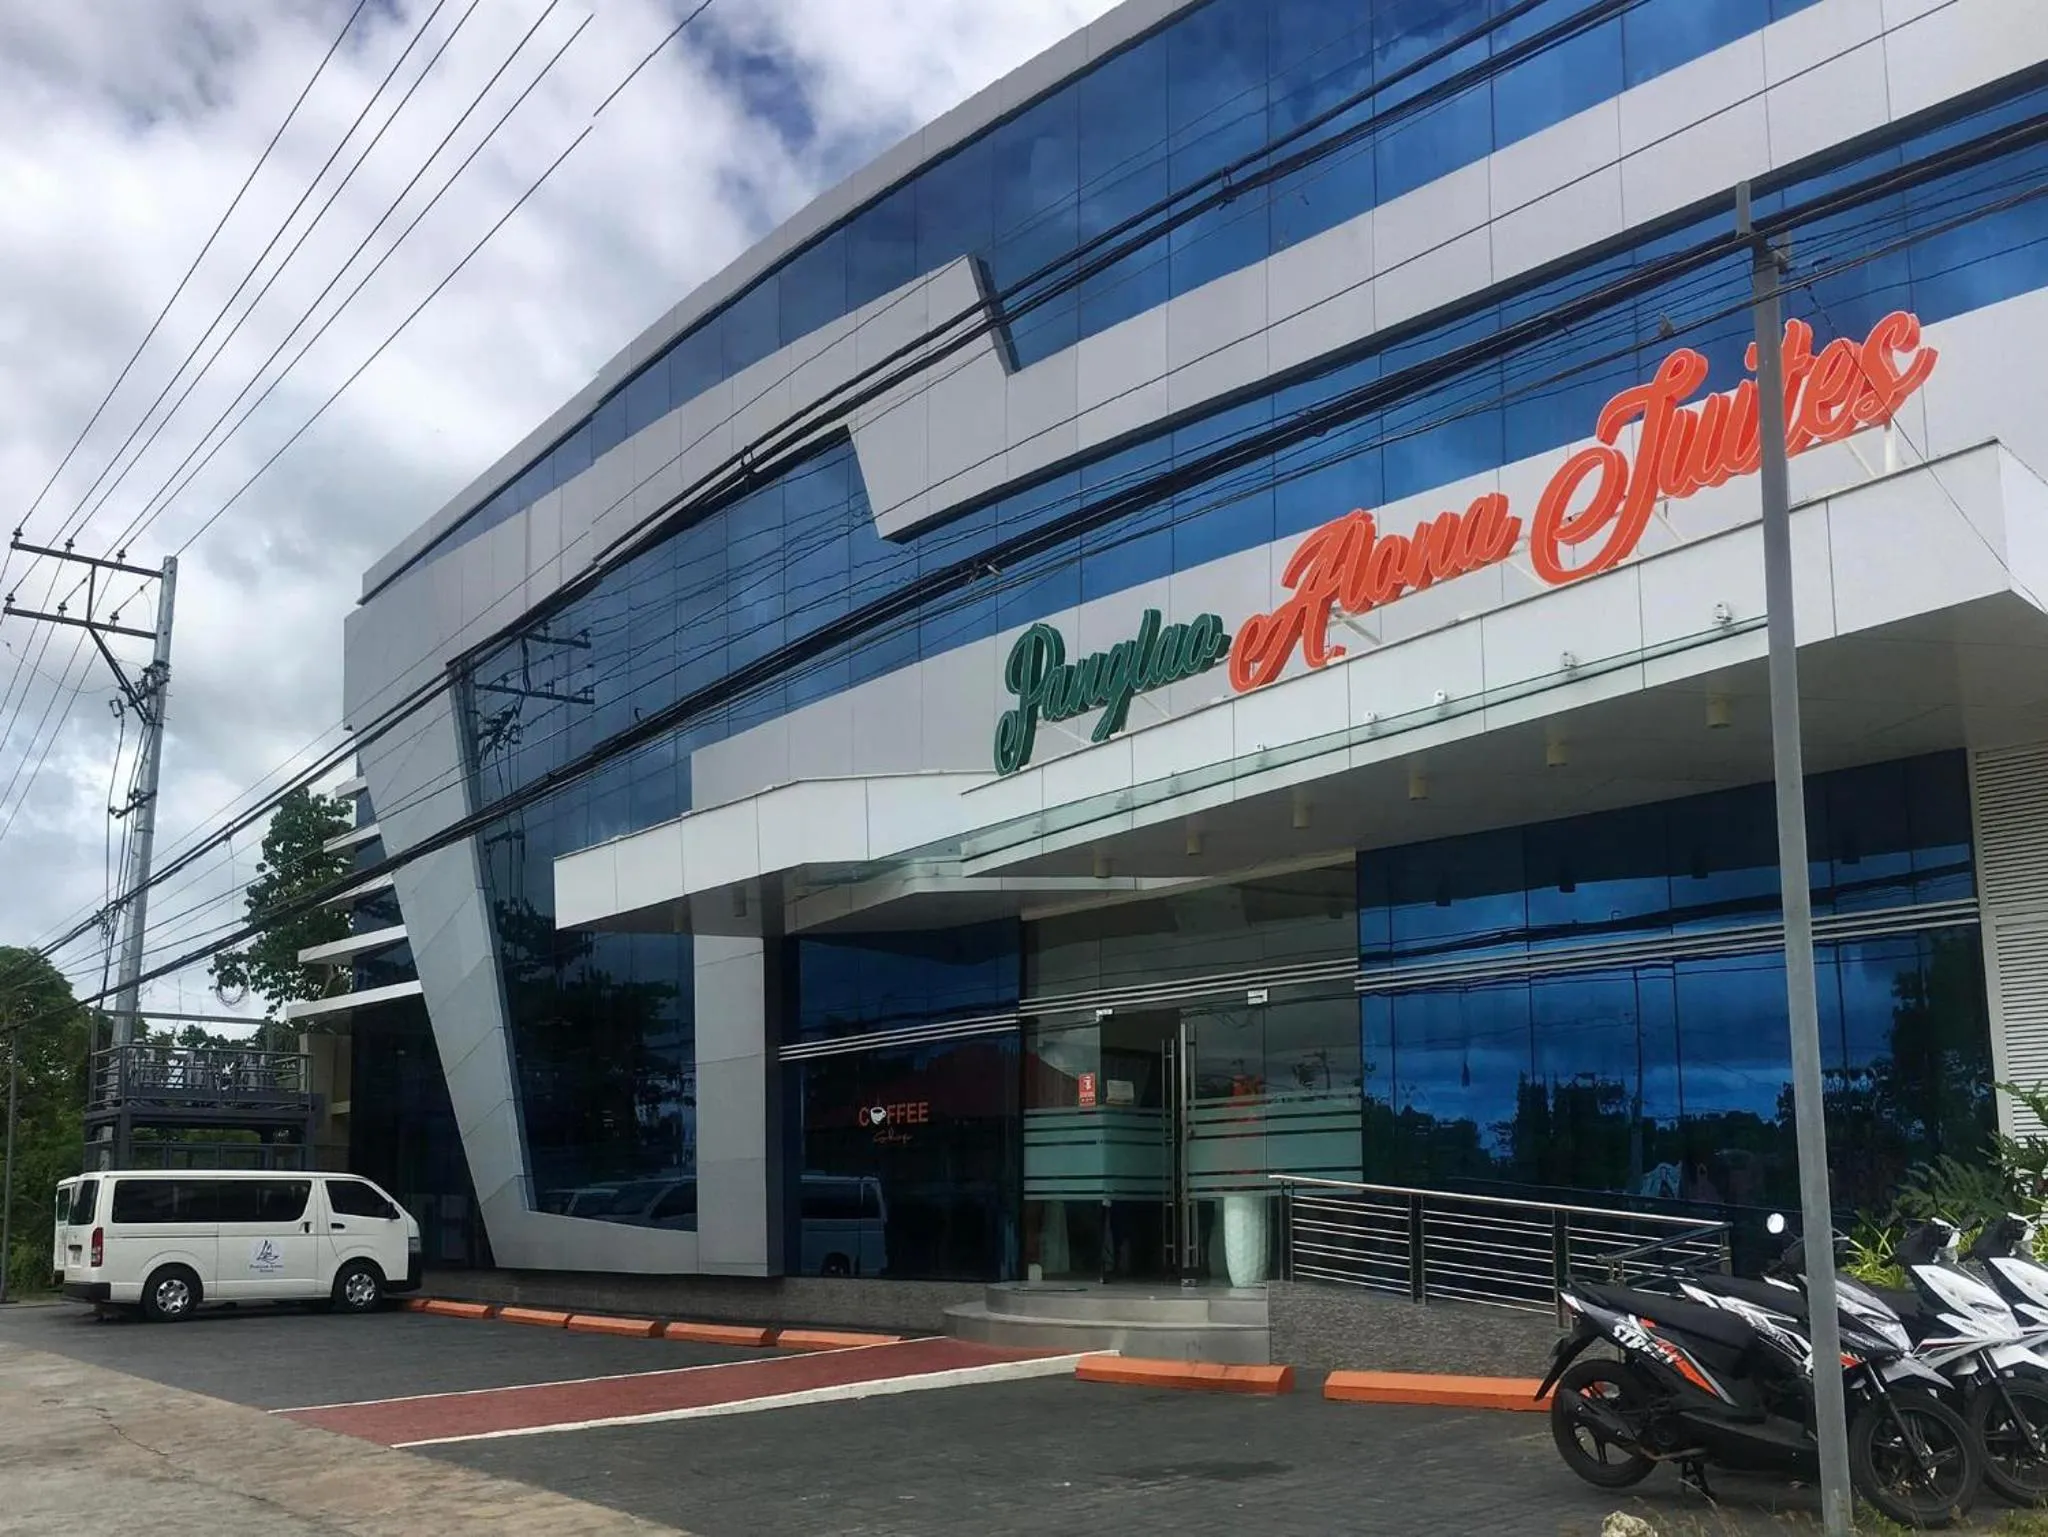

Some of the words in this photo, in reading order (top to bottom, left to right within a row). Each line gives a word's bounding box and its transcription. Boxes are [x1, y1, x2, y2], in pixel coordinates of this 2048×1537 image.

[994, 608, 1231, 776] Panglao
[1229, 492, 1522, 695] Alona
[1530, 311, 1939, 585] Suites
